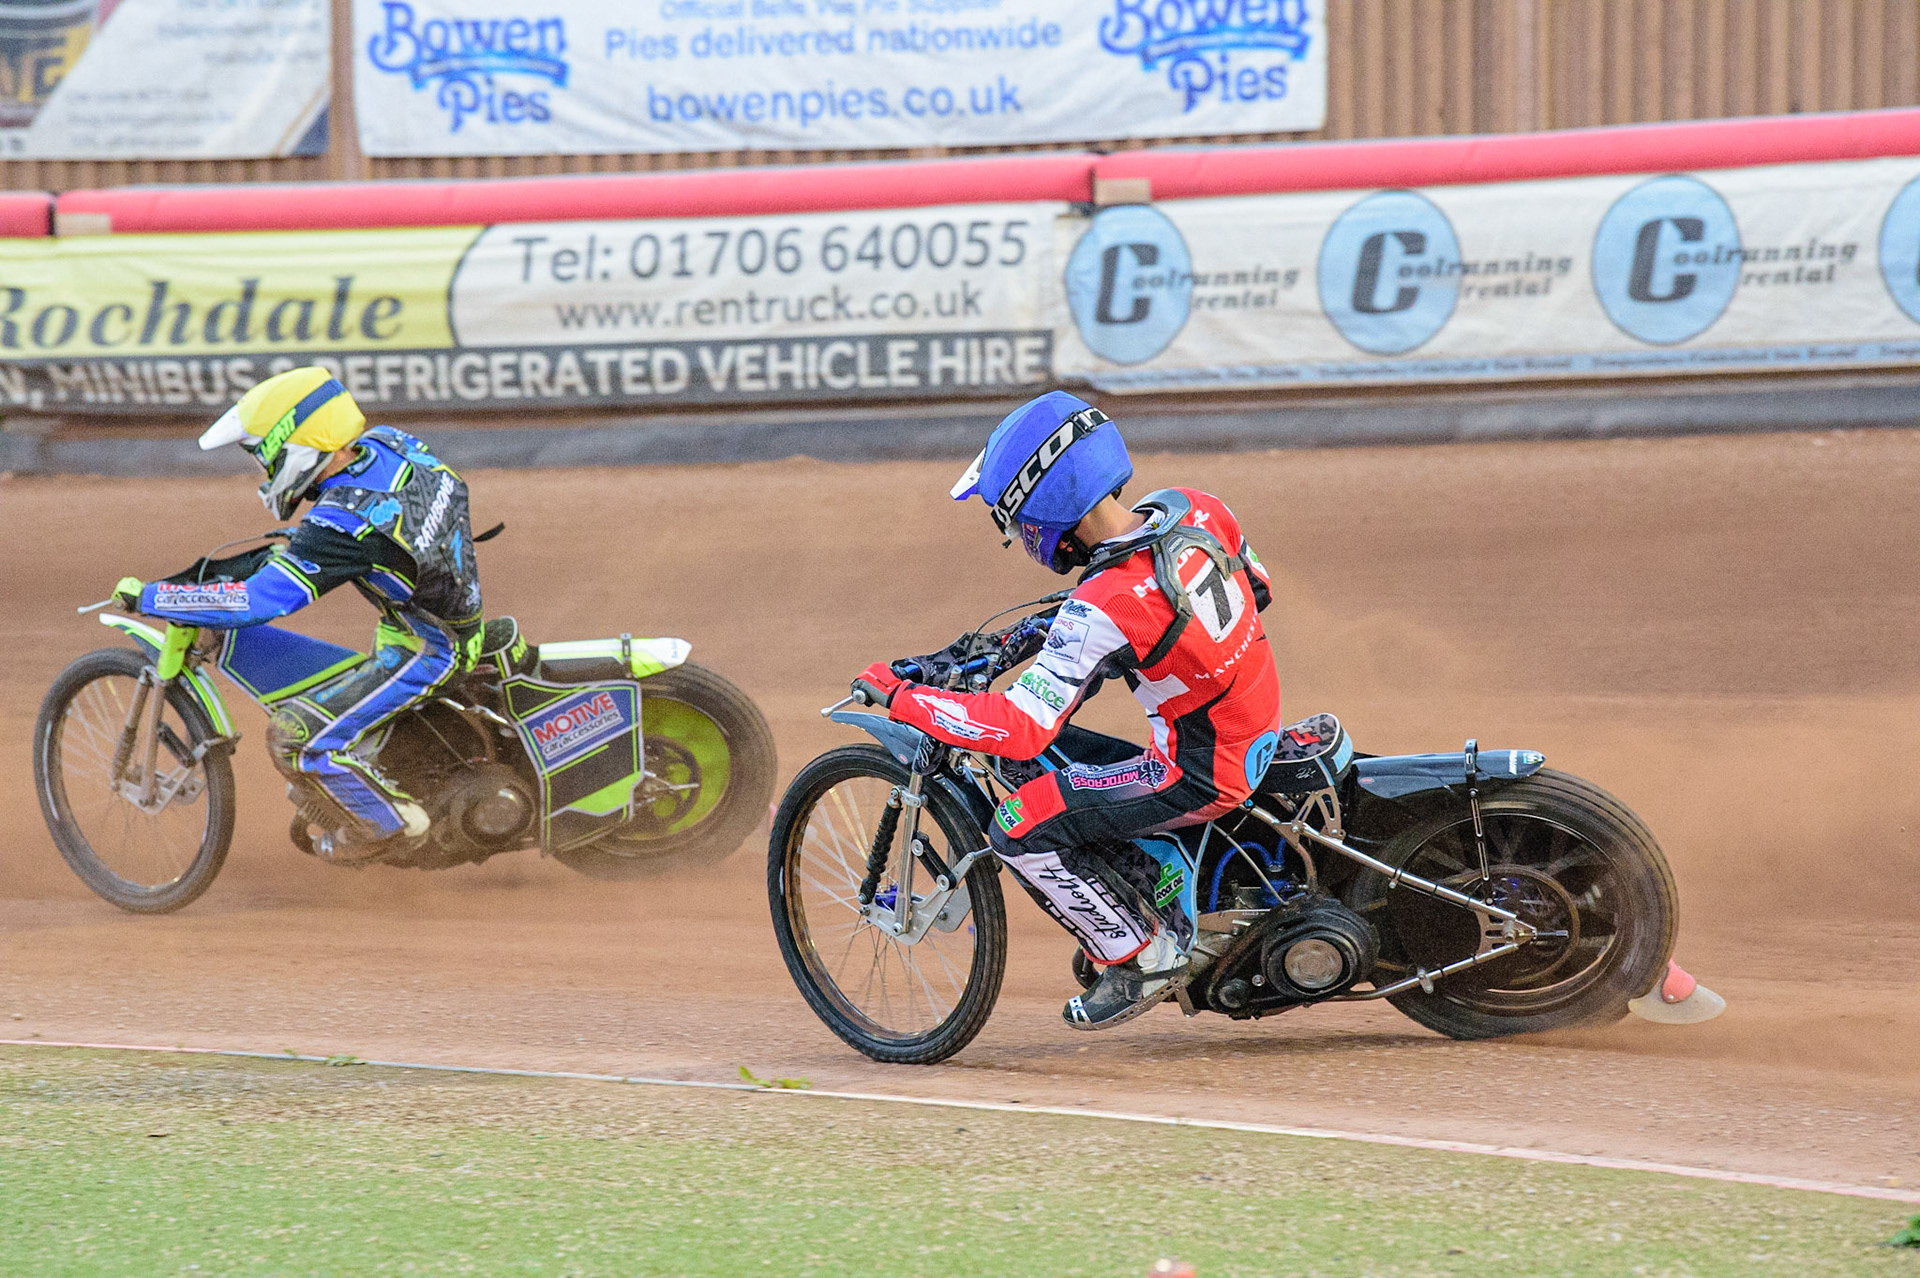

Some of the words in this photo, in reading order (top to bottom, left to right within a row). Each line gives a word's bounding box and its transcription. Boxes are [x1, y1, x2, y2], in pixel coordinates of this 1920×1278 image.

[368, 0, 567, 72] Bowen
[605, 27, 679, 59] Pies
[701, 25, 855, 58] delivered
[866, 18, 1061, 53] nationwide
[1098, 0, 1309, 55] Bowen
[437, 72, 551, 133] Pies
[647, 76, 1022, 127] bowenpies.co.uk
[1168, 52, 1288, 114] Pies
[512, 235, 613, 284] Tel:
[629, 227, 802, 279] 01706
[820, 220, 1031, 272] 640055
[1742, 263, 1838, 287] rental
[0, 275, 402, 350] Rochdale
[556, 281, 983, 331] www.rentruck.co.uk
[1463, 277, 1552, 299] rental
[47, 357, 256, 404] MINIBUS
[699, 338, 919, 393] VEHICLE
[929, 335, 1048, 386] HIRE
[414, 470, 455, 552] RATHBONE
[1195, 566, 1232, 631] 7
[533, 691, 615, 744] MOTIVE
[1156, 882, 1174, 901] ROCK
[1173, 875, 1185, 888] OIL
